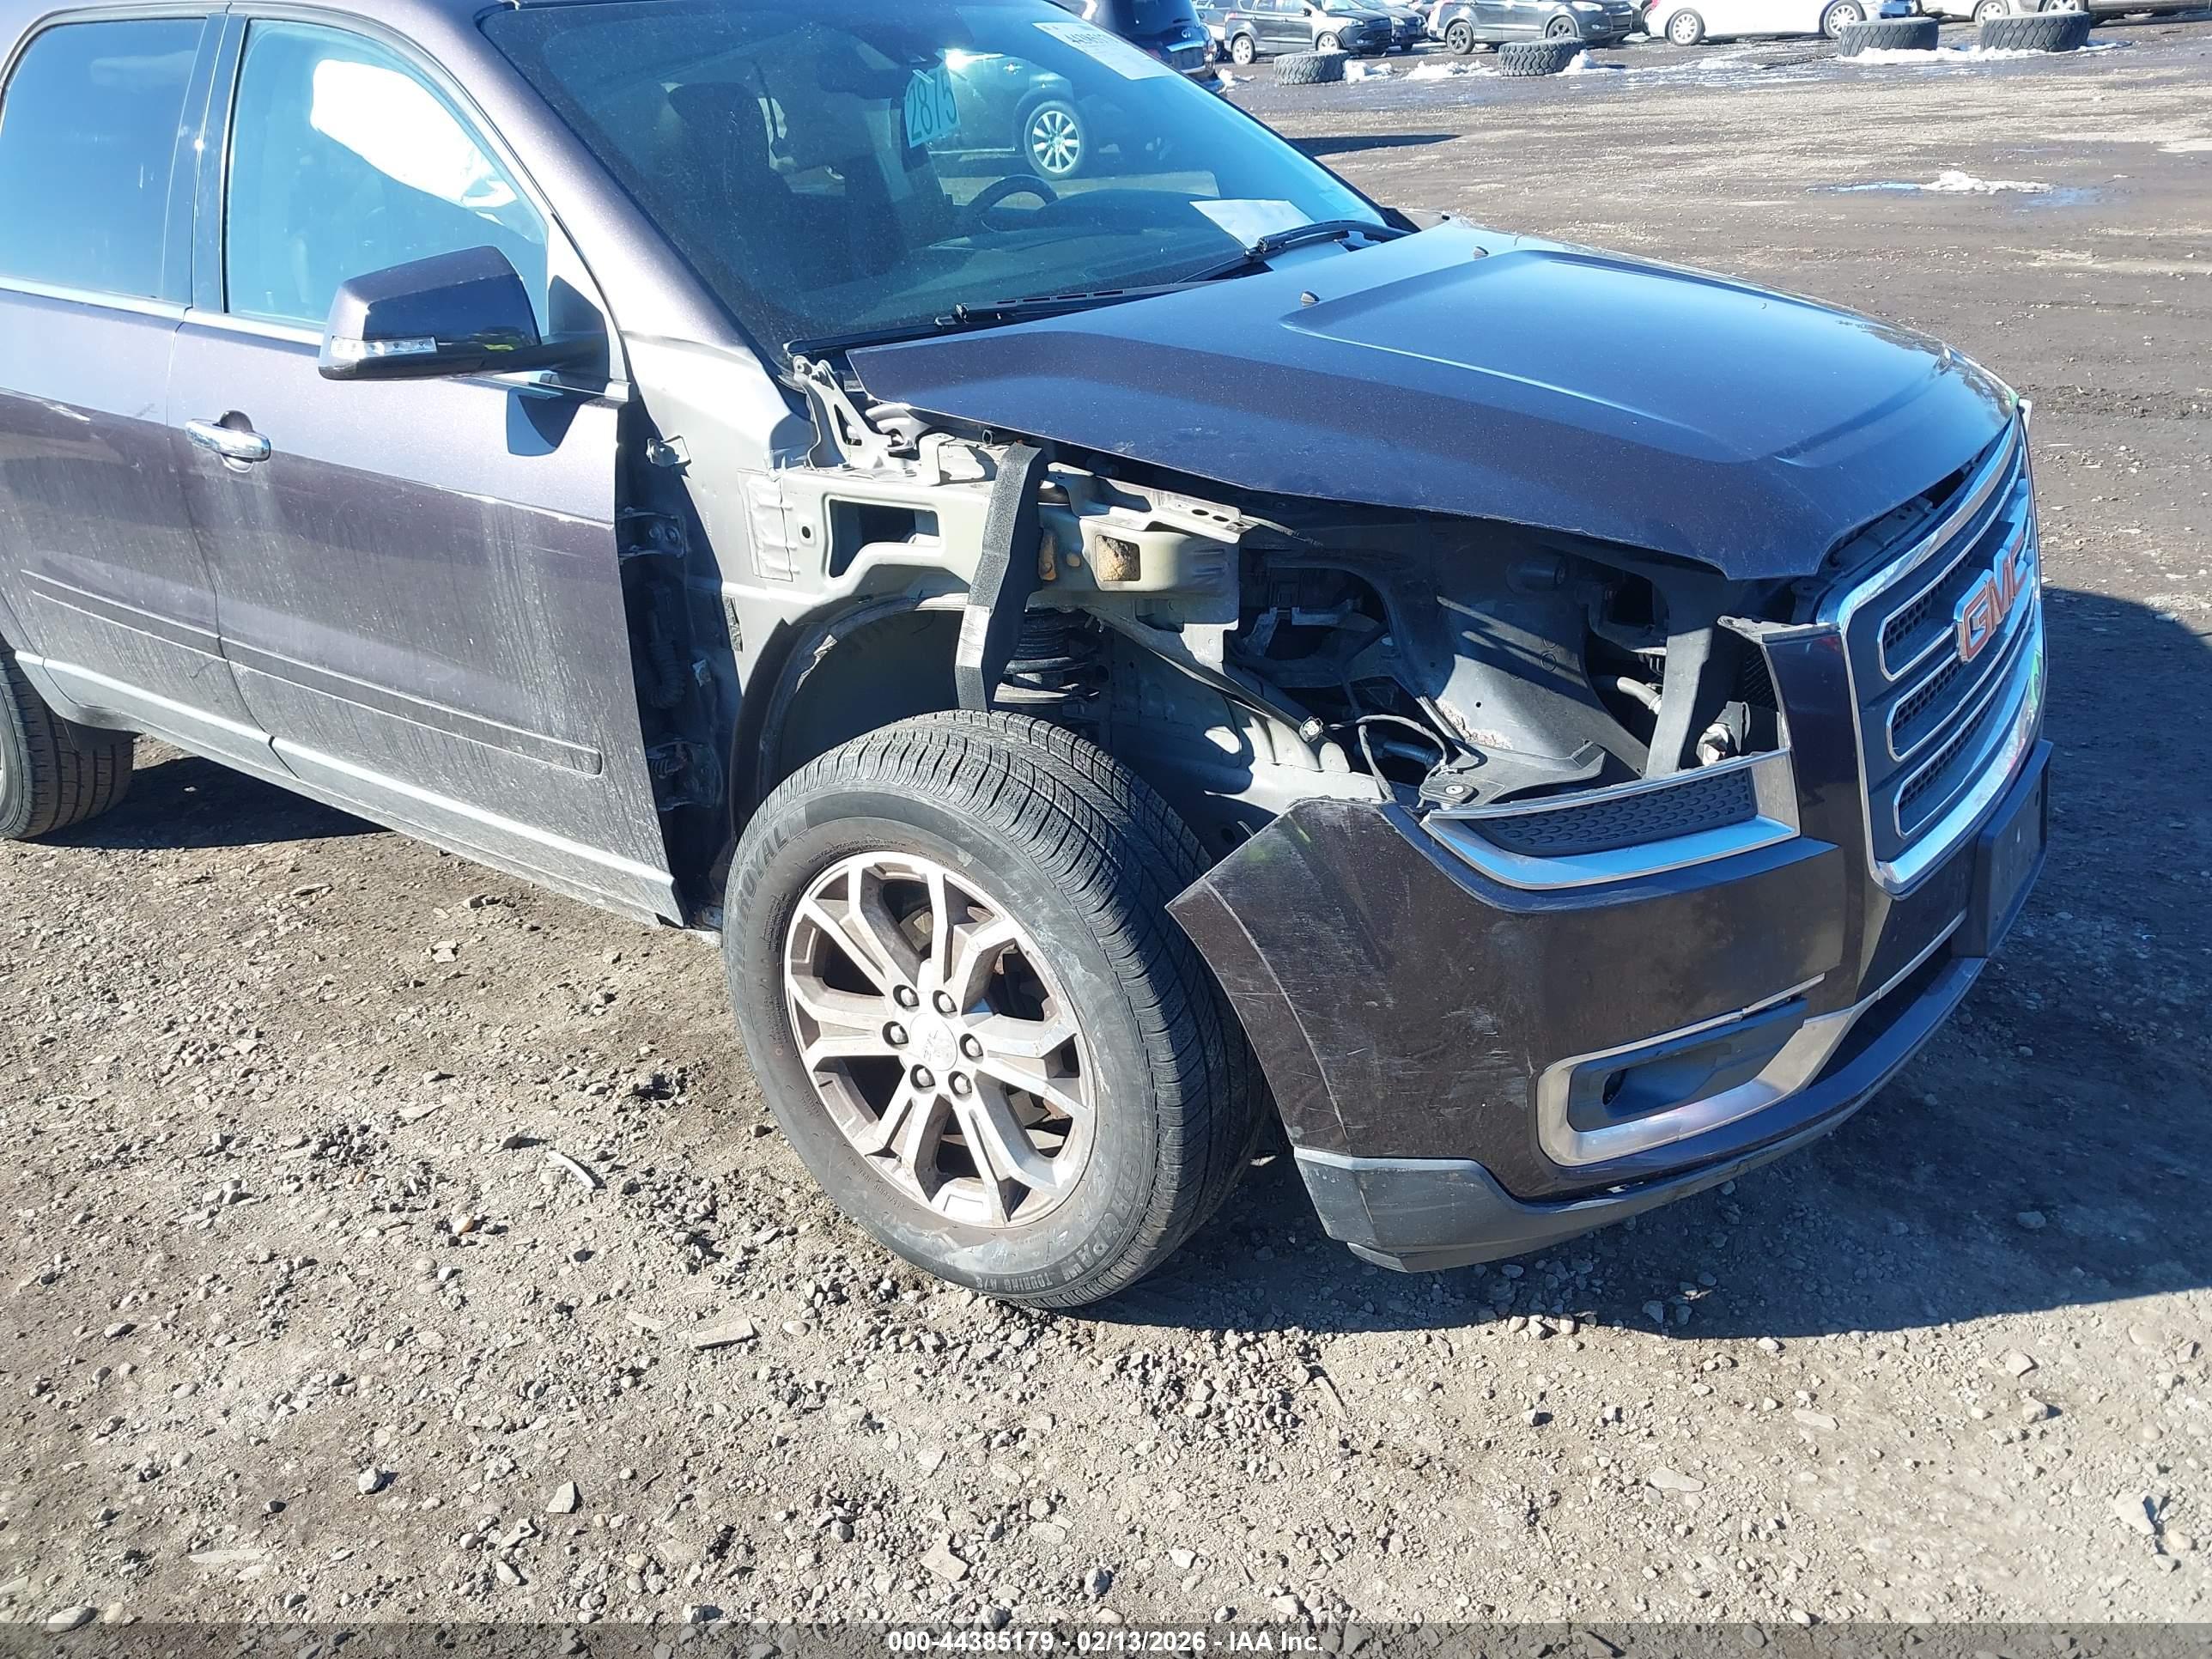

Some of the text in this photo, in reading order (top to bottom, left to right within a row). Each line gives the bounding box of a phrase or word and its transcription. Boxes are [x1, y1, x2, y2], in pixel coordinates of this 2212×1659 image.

[1955, 526, 2027, 662] GMC
[1003, 1272, 1054, 1292] TOURING
[1059, 1230, 1111, 1282] PAW
